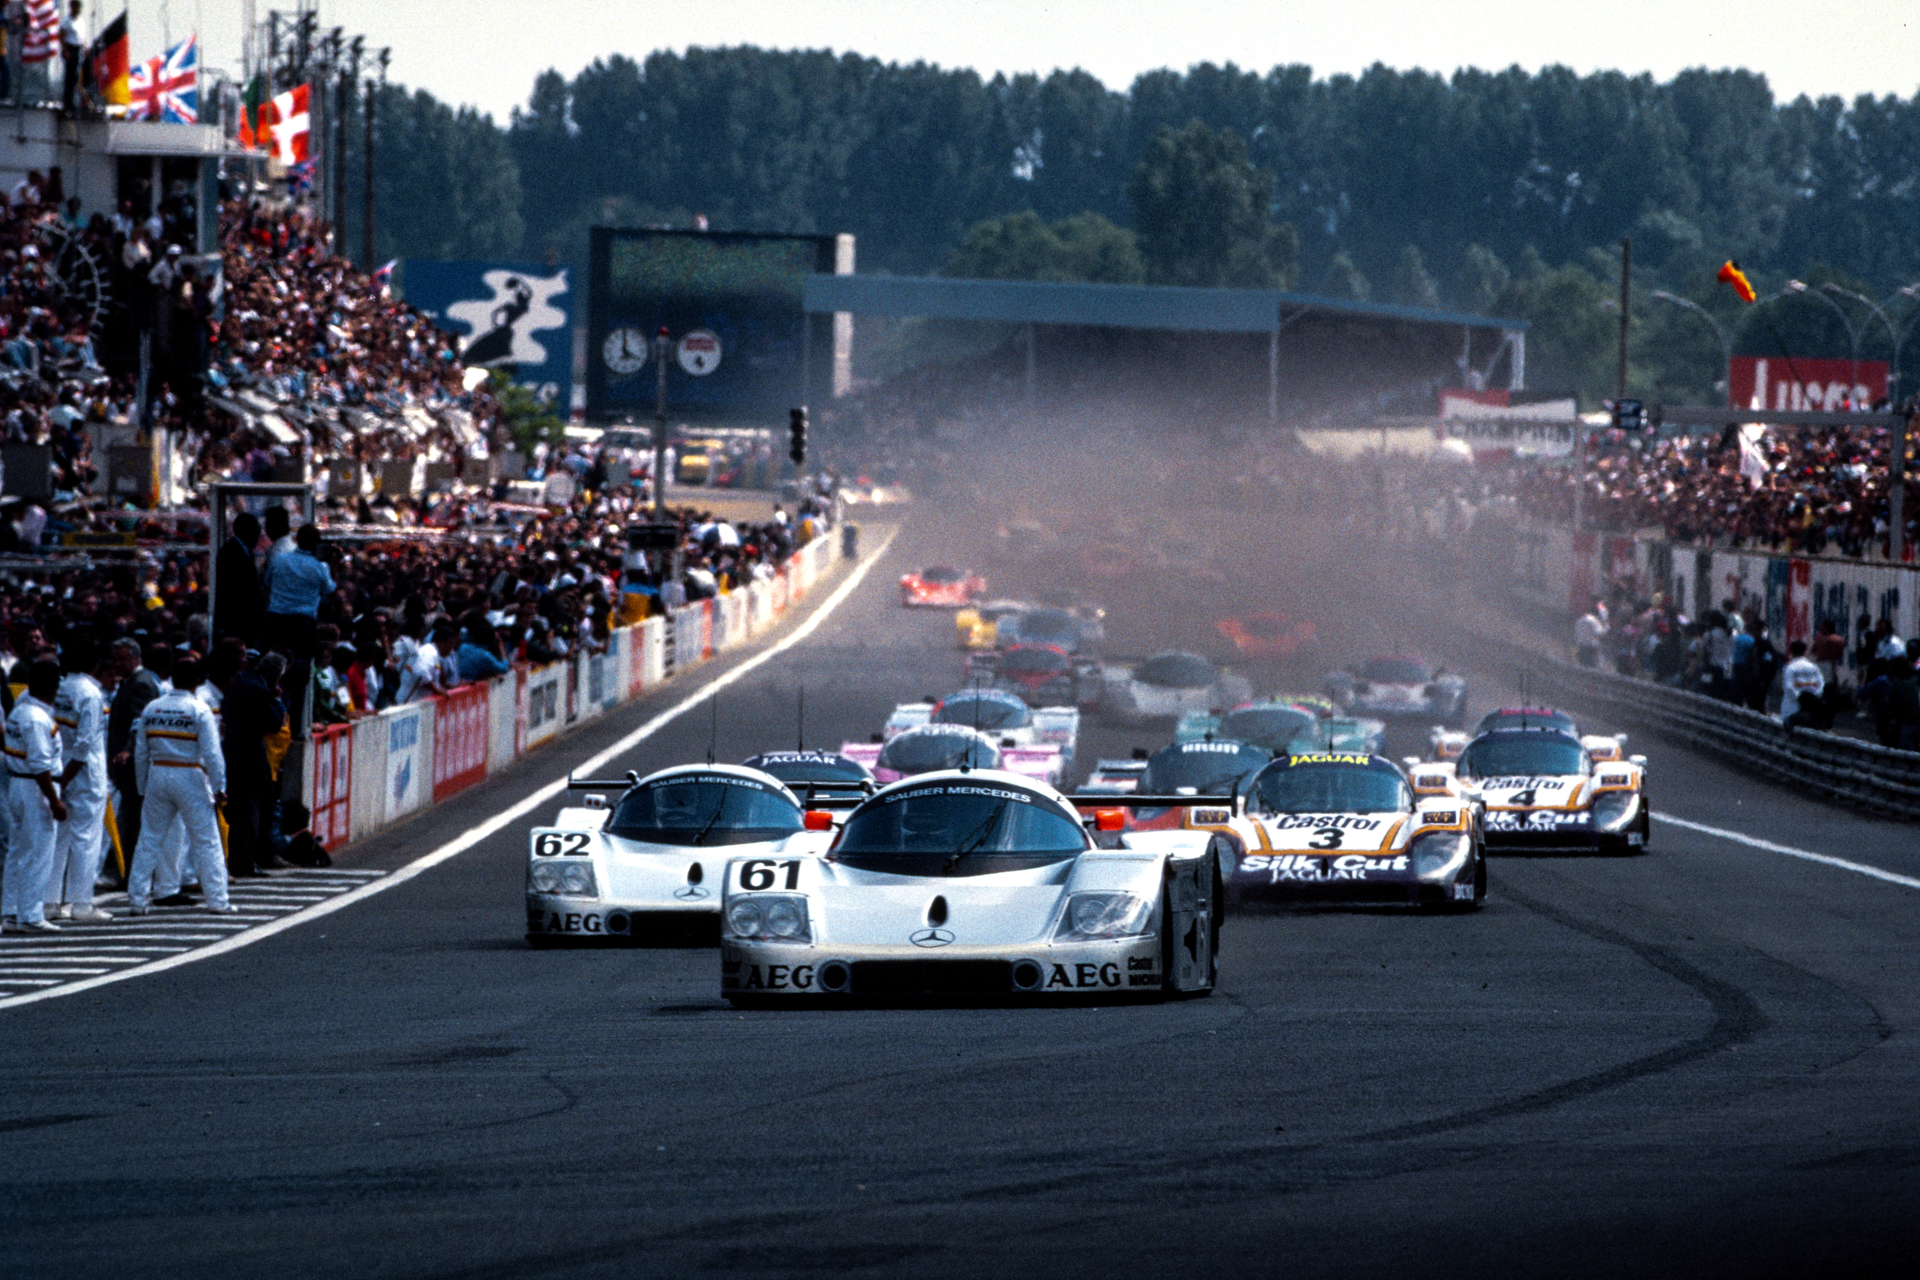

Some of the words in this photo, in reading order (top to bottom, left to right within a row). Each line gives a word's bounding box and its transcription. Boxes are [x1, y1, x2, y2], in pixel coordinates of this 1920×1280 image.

[761, 755, 836, 766] JAGUAR
[1290, 755, 1369, 767] JAGUAR
[651, 777, 696, 788] SAUBER
[698, 776, 764, 790] MERCEDES
[1482, 776, 1565, 790] Castrol
[885, 787, 944, 804] SAUBER
[947, 787, 1031, 803] MERCEDES
[1508, 789, 1537, 805] 4
[1276, 814, 1382, 831] Castrol
[1528, 810, 1592, 824] Cut
[1485, 822, 1557, 832] AGUAR
[535, 833, 592, 857] 62
[1308, 828, 1345, 850] 3
[1240, 855, 1321, 872] Silk
[1333, 855, 1411, 872] Cut
[740, 860, 801, 891] 61
[1270, 870, 1367, 883] JAGUAR
[547, 913, 603, 932] AEG
[745, 965, 815, 989] AEG
[1046, 963, 1121, 987] AEG
